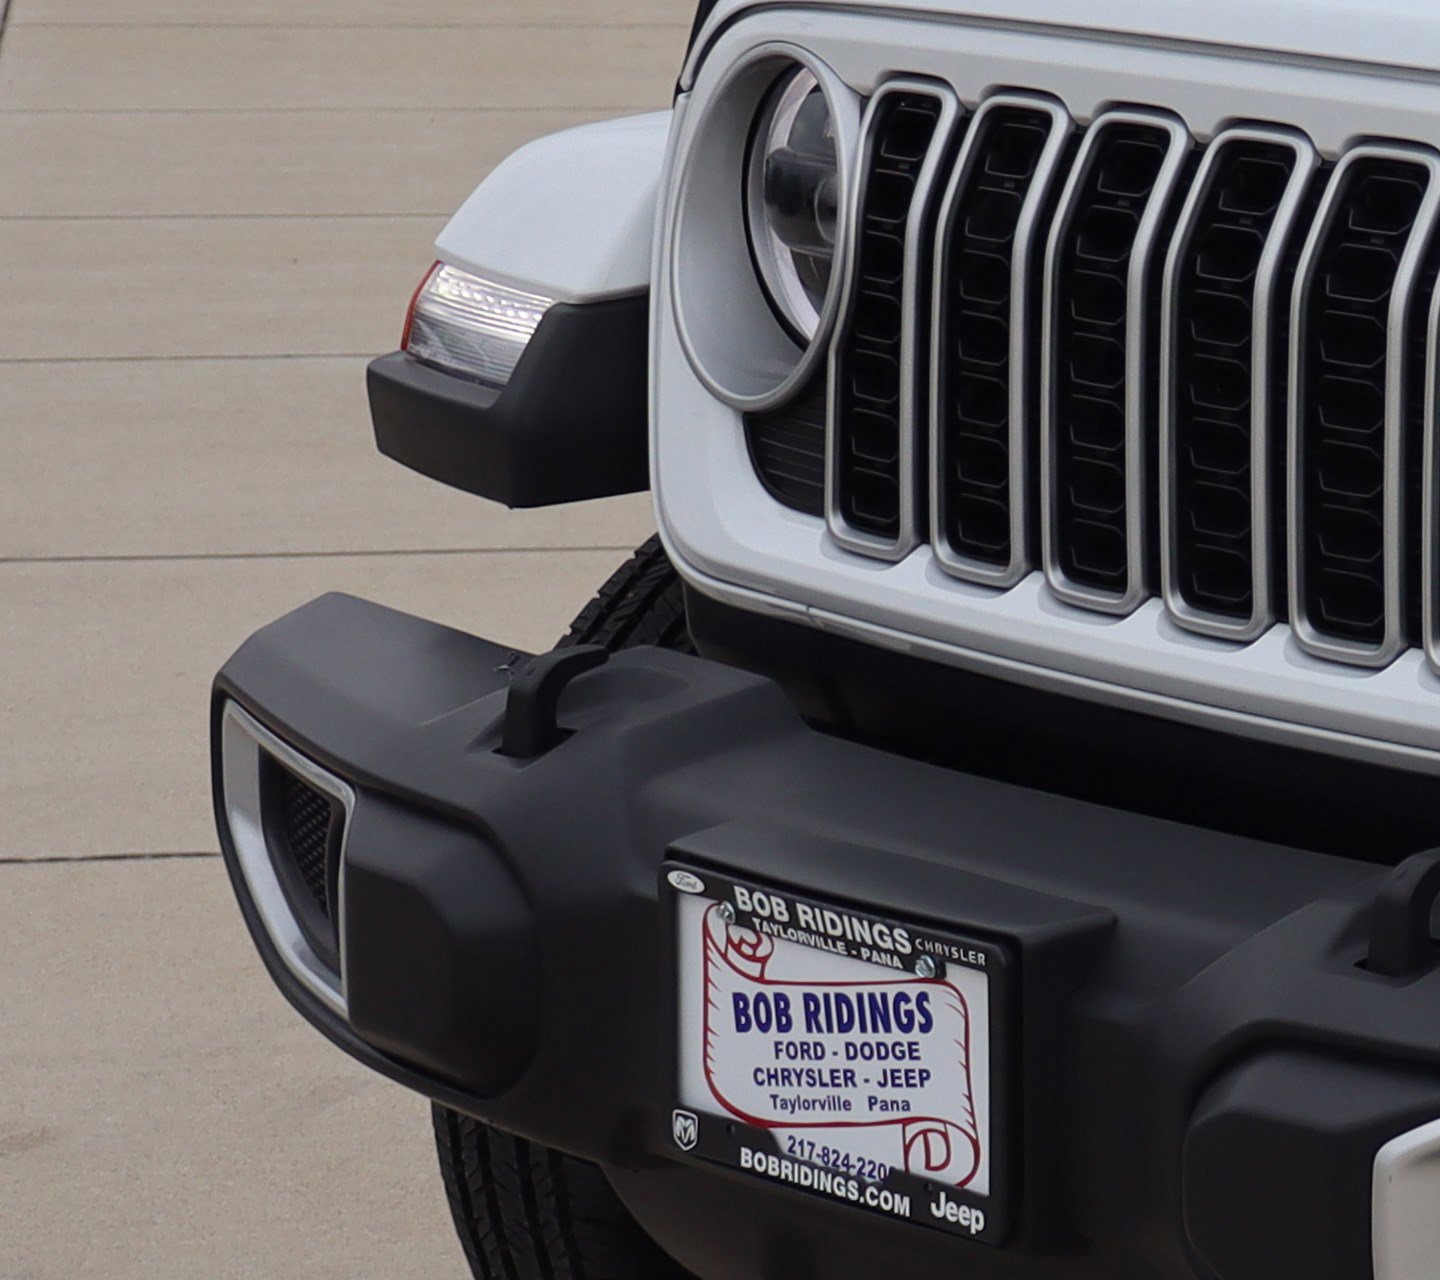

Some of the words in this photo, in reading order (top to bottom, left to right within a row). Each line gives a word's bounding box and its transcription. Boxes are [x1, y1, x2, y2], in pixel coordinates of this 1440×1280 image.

[734, 885, 790, 923] BOB
[797, 903, 912, 954] RIDINGS
[752, 918, 847, 956] TAYLORVILLE
[861, 947, 903, 969] PANA
[915, 938, 986, 966] CHRYSLER
[732, 992, 793, 1033] BOB
[803, 991, 934, 1034] RIDINGS
[774, 1041, 826, 1061] FORD
[844, 1041, 921, 1061] DODGE
[753, 1067, 857, 1088] CHRYSLER
[877, 1068, 932, 1089] JEEP
[770, 1094, 852, 1116] Taylorville
[868, 1096, 911, 1112] Pana
[740, 1147, 911, 1217] BOBRIDINGS.COM
[930, 1191, 985, 1234] Jeep
